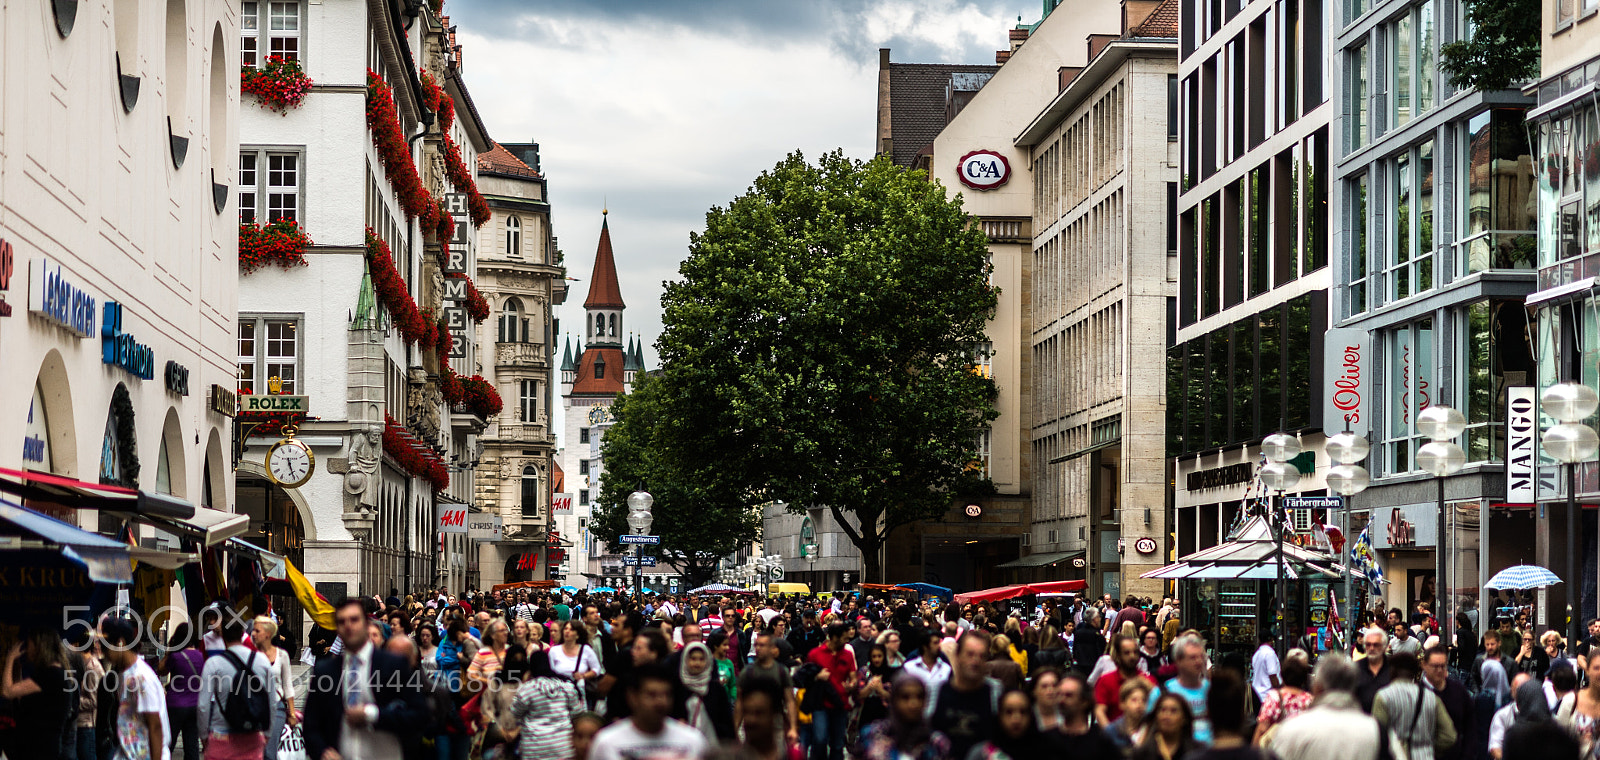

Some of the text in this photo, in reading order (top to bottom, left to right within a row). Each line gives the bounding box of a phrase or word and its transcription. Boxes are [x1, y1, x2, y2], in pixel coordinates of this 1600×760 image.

[967, 160, 1001, 178] C&A
[446, 195, 467, 356] HIRMER
[1332, 343, 1361, 424] s.Oliver
[249, 397, 301, 410] ROLEX
[1511, 398, 1532, 491] MANGO
[552, 498, 571, 511] H&M
[1286, 498, 1340, 508] Färbergraben
[440, 510, 466, 527] H&M
[470, 522, 493, 530] CHRIST
[1139, 542, 1153, 550] C&A
[517, 553, 538, 571] H&M
